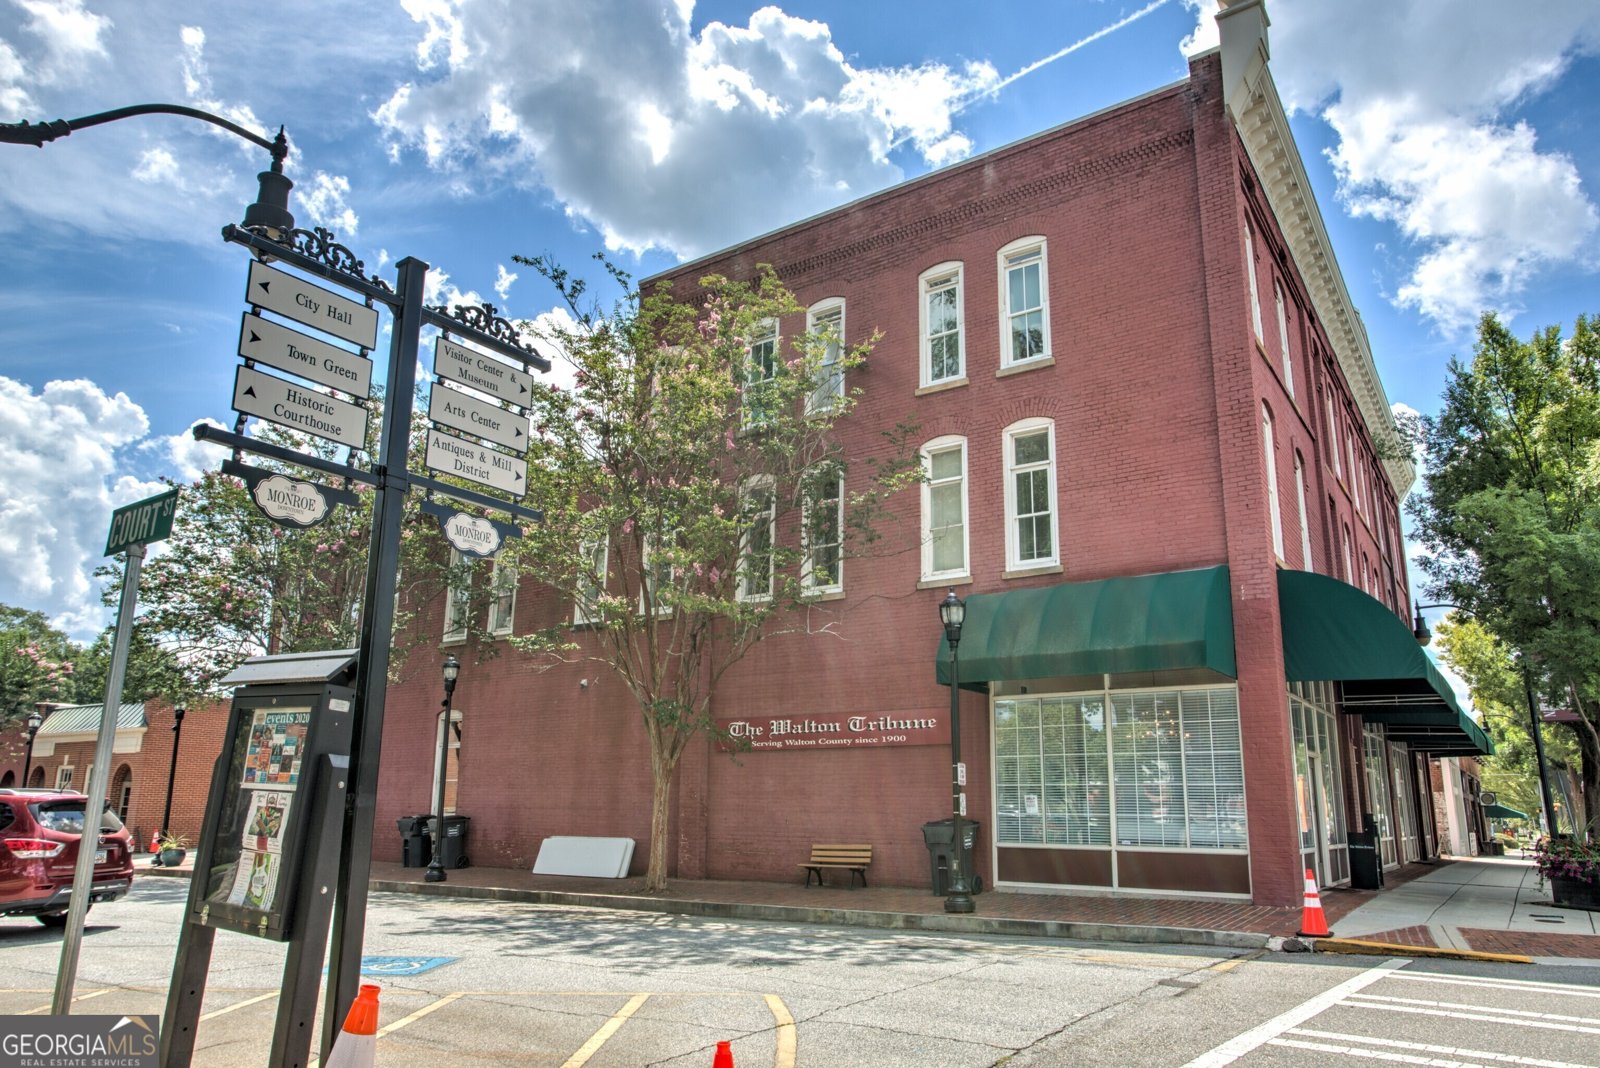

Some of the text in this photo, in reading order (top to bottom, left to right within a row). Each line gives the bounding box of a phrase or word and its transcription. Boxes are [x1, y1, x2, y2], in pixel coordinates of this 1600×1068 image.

[295, 293, 352, 325] City Hall
[287, 344, 358, 381] Town Green
[444, 345, 517, 384] Visitor Center &
[458, 367, 499, 392] Museum
[286, 388, 335, 416] Historic
[444, 401, 501, 431] Arts Center
[274, 403, 342, 436] Courthouse
[432, 437, 512, 472] Antiques & Mill
[453, 459, 490, 480] District
[267, 488, 317, 512] MONROE
[110, 498, 175, 548] COURT ST
[454, 524, 492, 544] MONROE
[266, 713, 294, 724] events
[294, 713, 310, 724] 2020
[728, 716, 937, 739] The Walton Tribune
[751, 735, 907, 748] Serving Walton County since 1900
